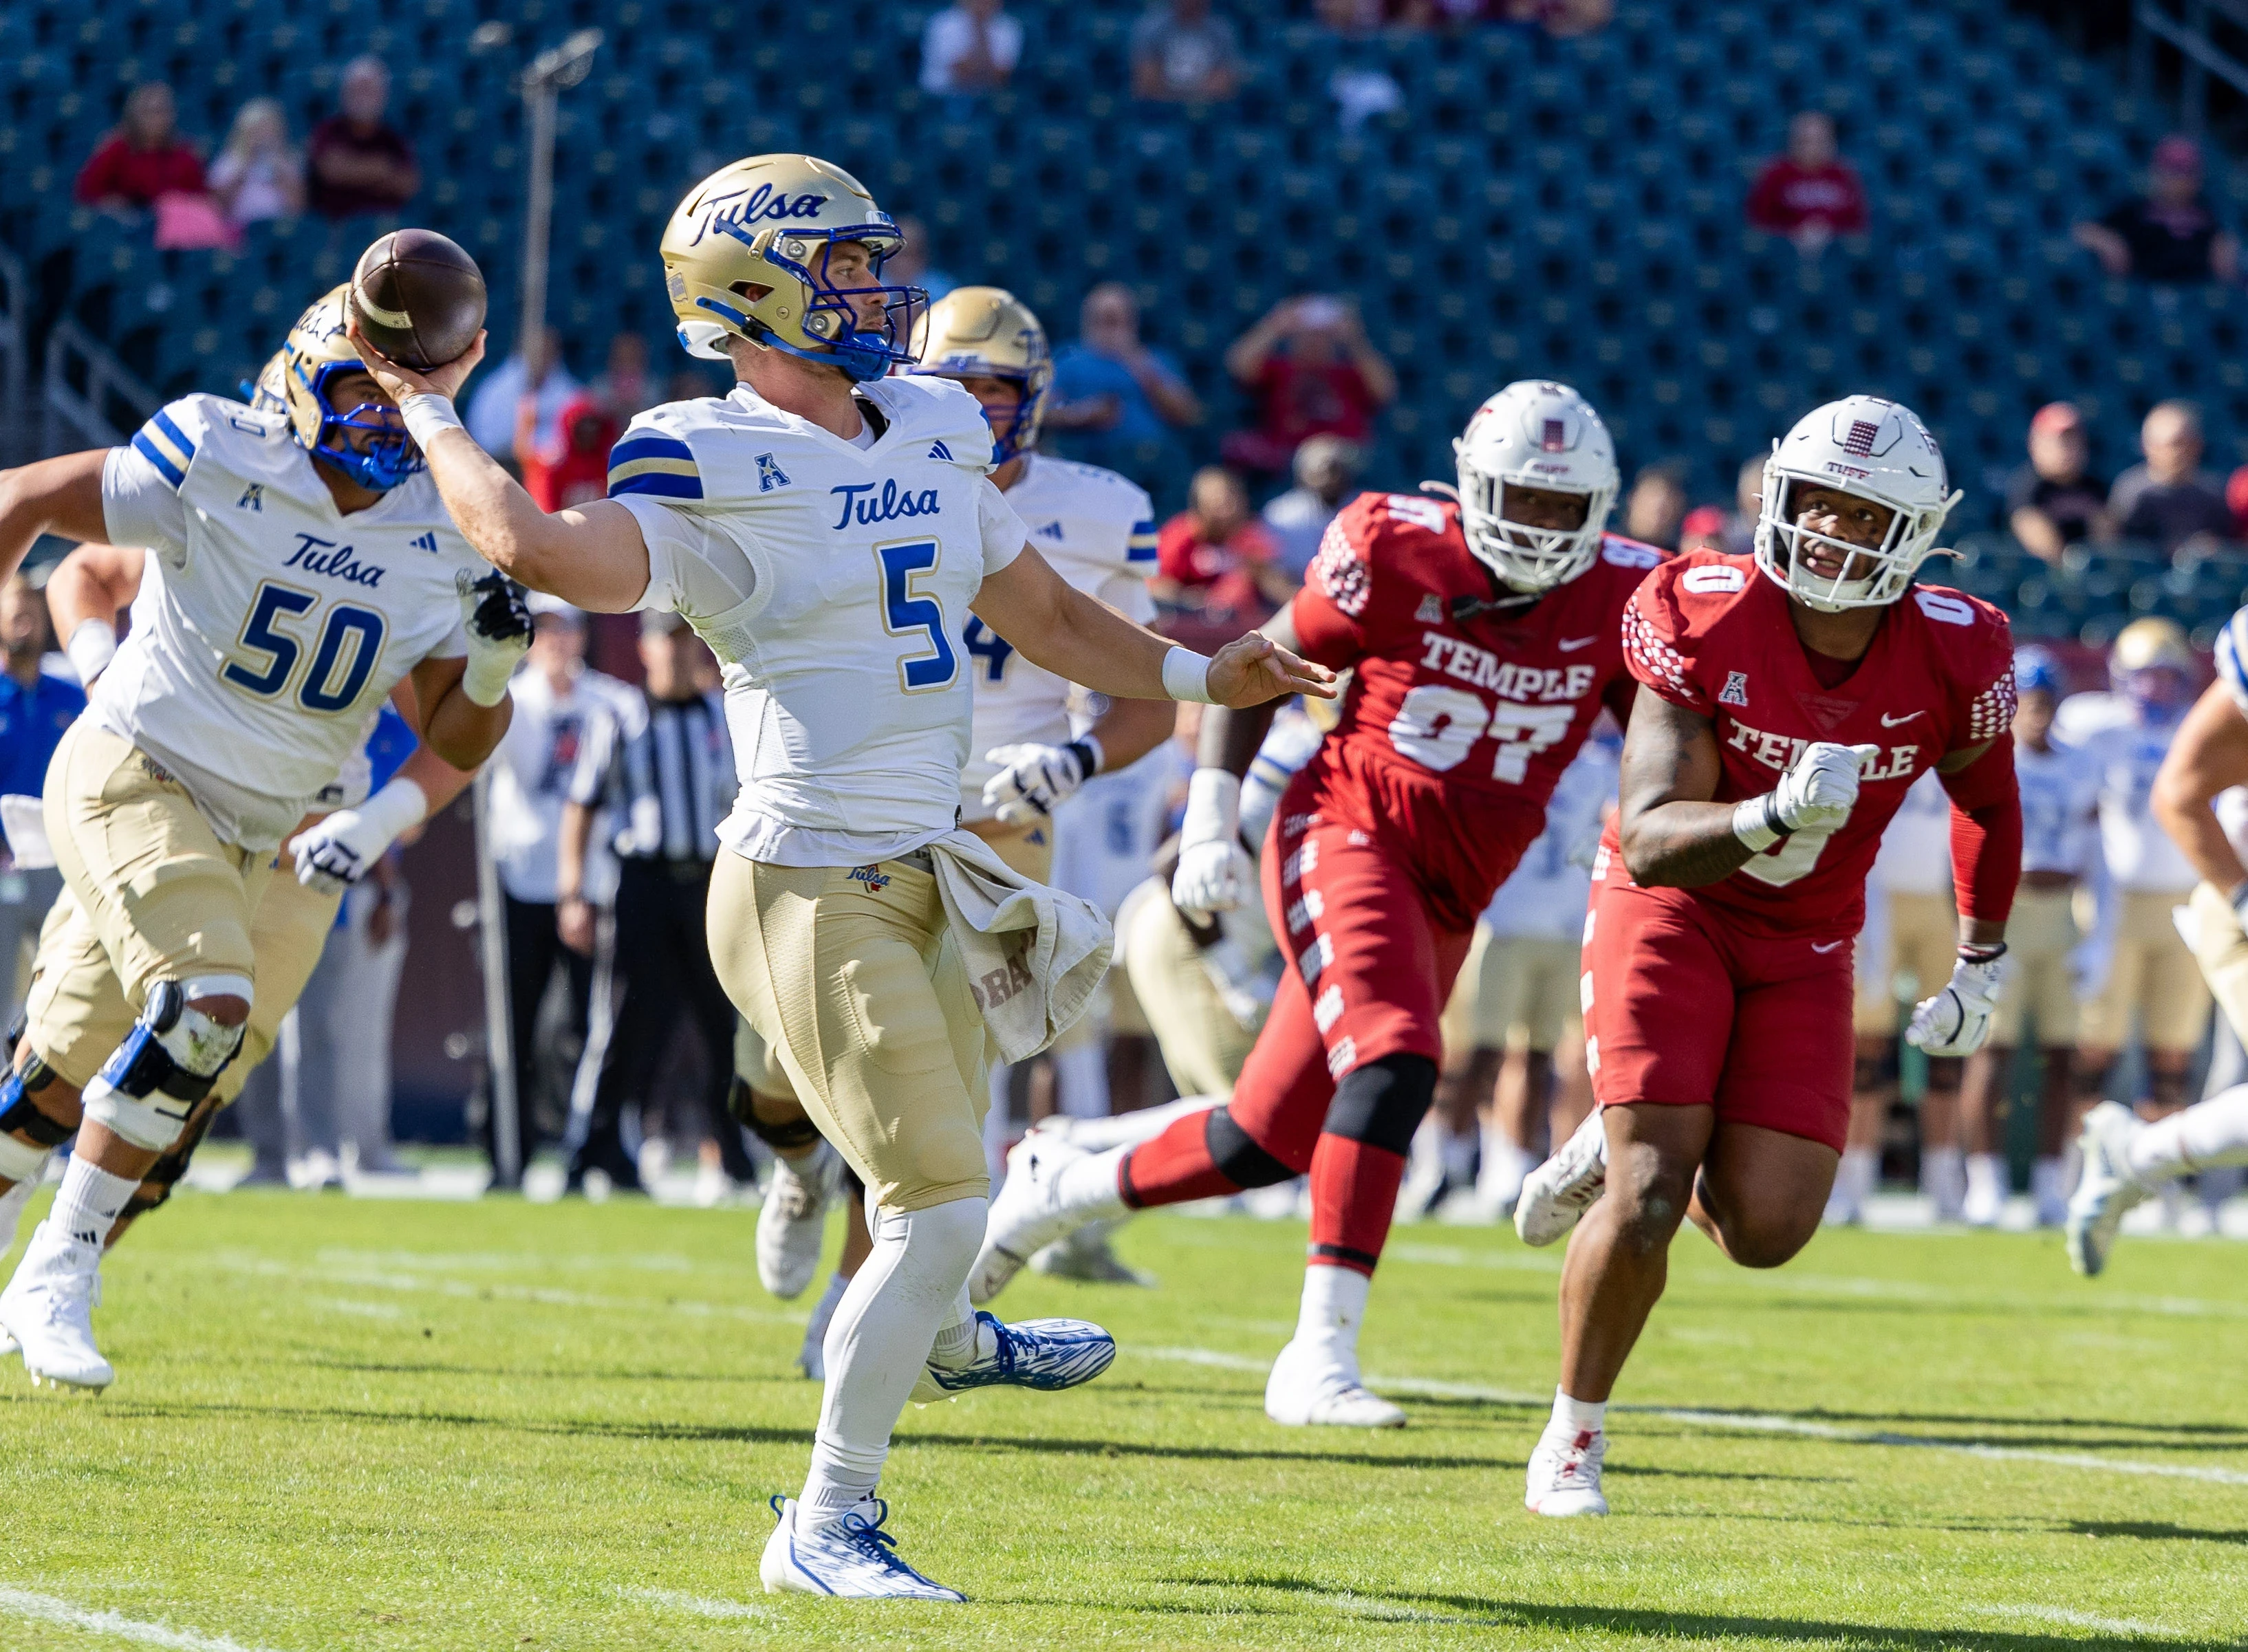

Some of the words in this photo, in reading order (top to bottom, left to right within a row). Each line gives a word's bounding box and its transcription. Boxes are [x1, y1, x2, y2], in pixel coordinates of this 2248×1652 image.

[689, 182, 830, 246] Tulsa
[830, 478, 940, 530] Tulsa
[282, 532, 386, 588] Tulsa
[872, 534, 960, 696] 5
[217, 578, 390, 717] 50
[1420, 630, 1596, 702] TEMPLE
[1727, 717, 1919, 781] TELE
[845, 866, 892, 887] Tulsa
